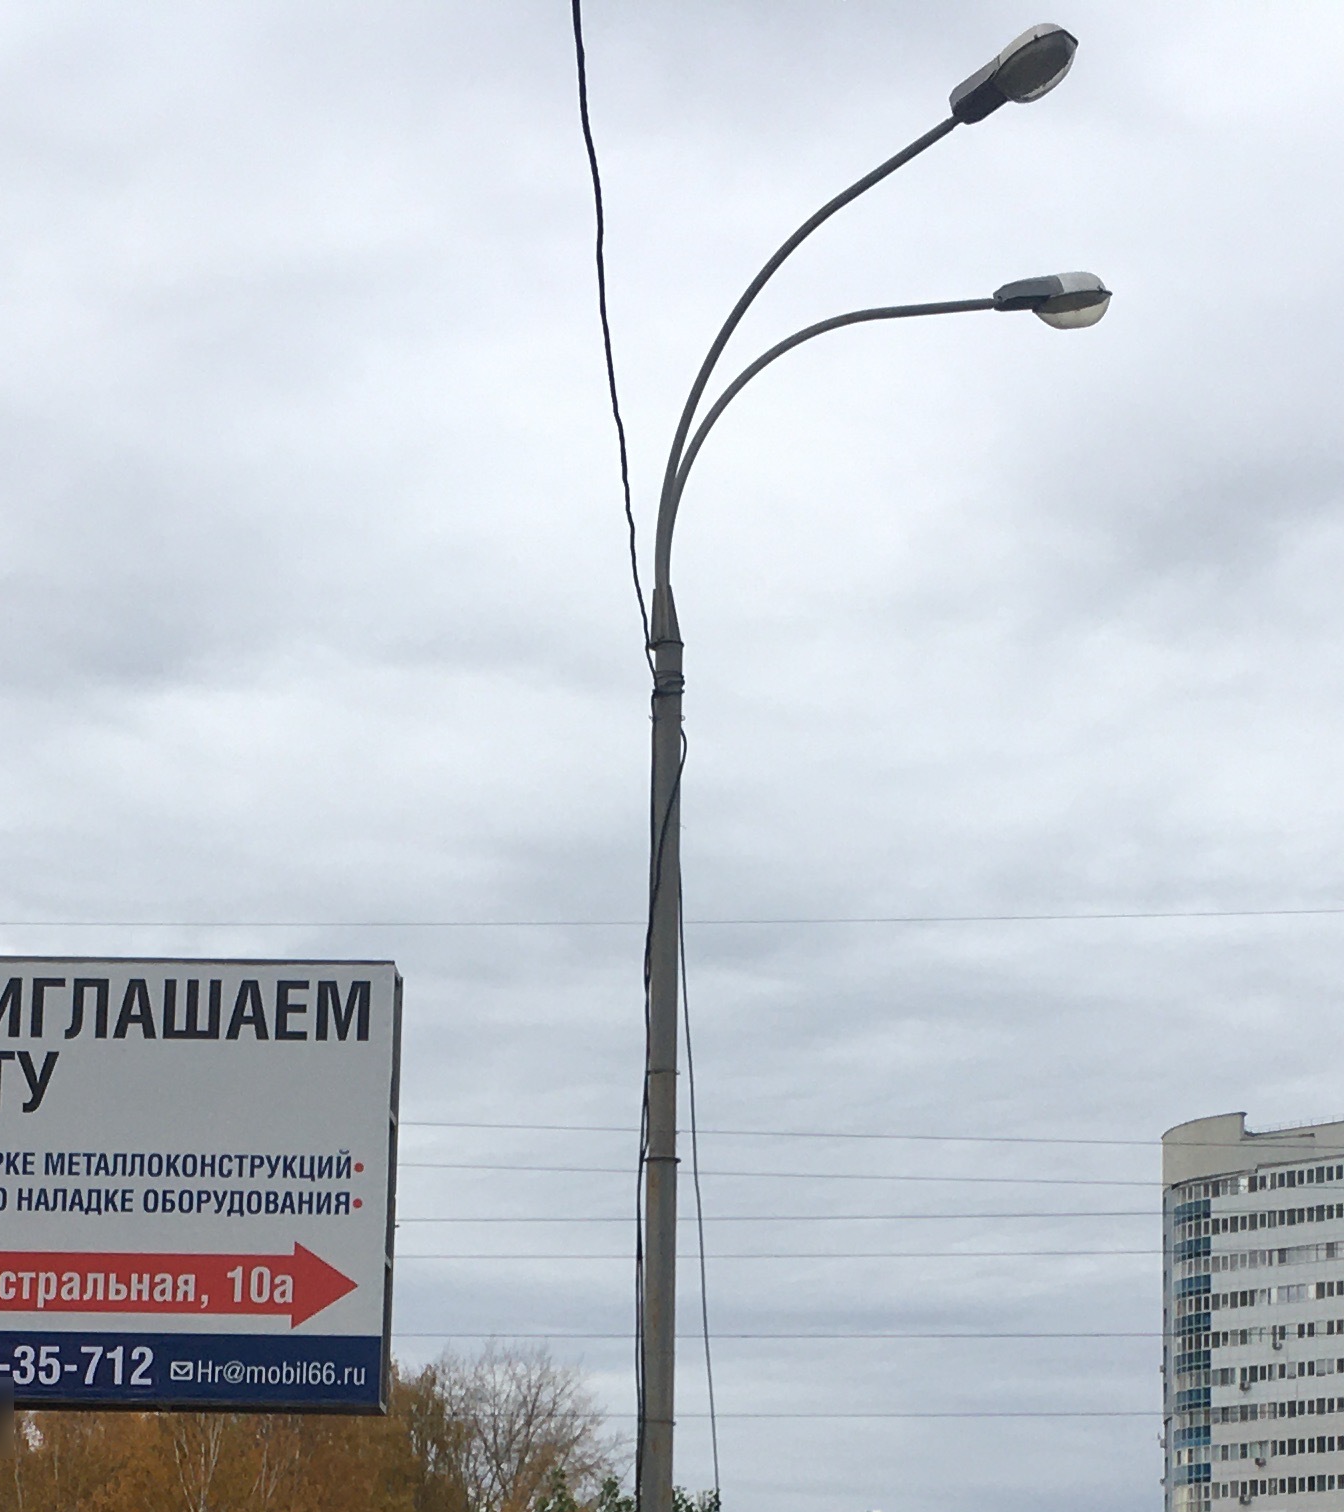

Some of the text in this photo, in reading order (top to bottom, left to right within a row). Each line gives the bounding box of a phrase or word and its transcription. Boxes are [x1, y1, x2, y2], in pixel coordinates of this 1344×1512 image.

[43, 1148, 353, 1182] МЕТАЛЛОКОНСТРУКЦИЙ
[16, 1187, 135, 1216] НАЛАДКЕ
[142, 1188, 351, 1217] ОБОРУДОВАНИЯ
[226, 1266, 296, 1304] 10а
[197, 1359, 366, 1386] Hr@mobil66.ru
